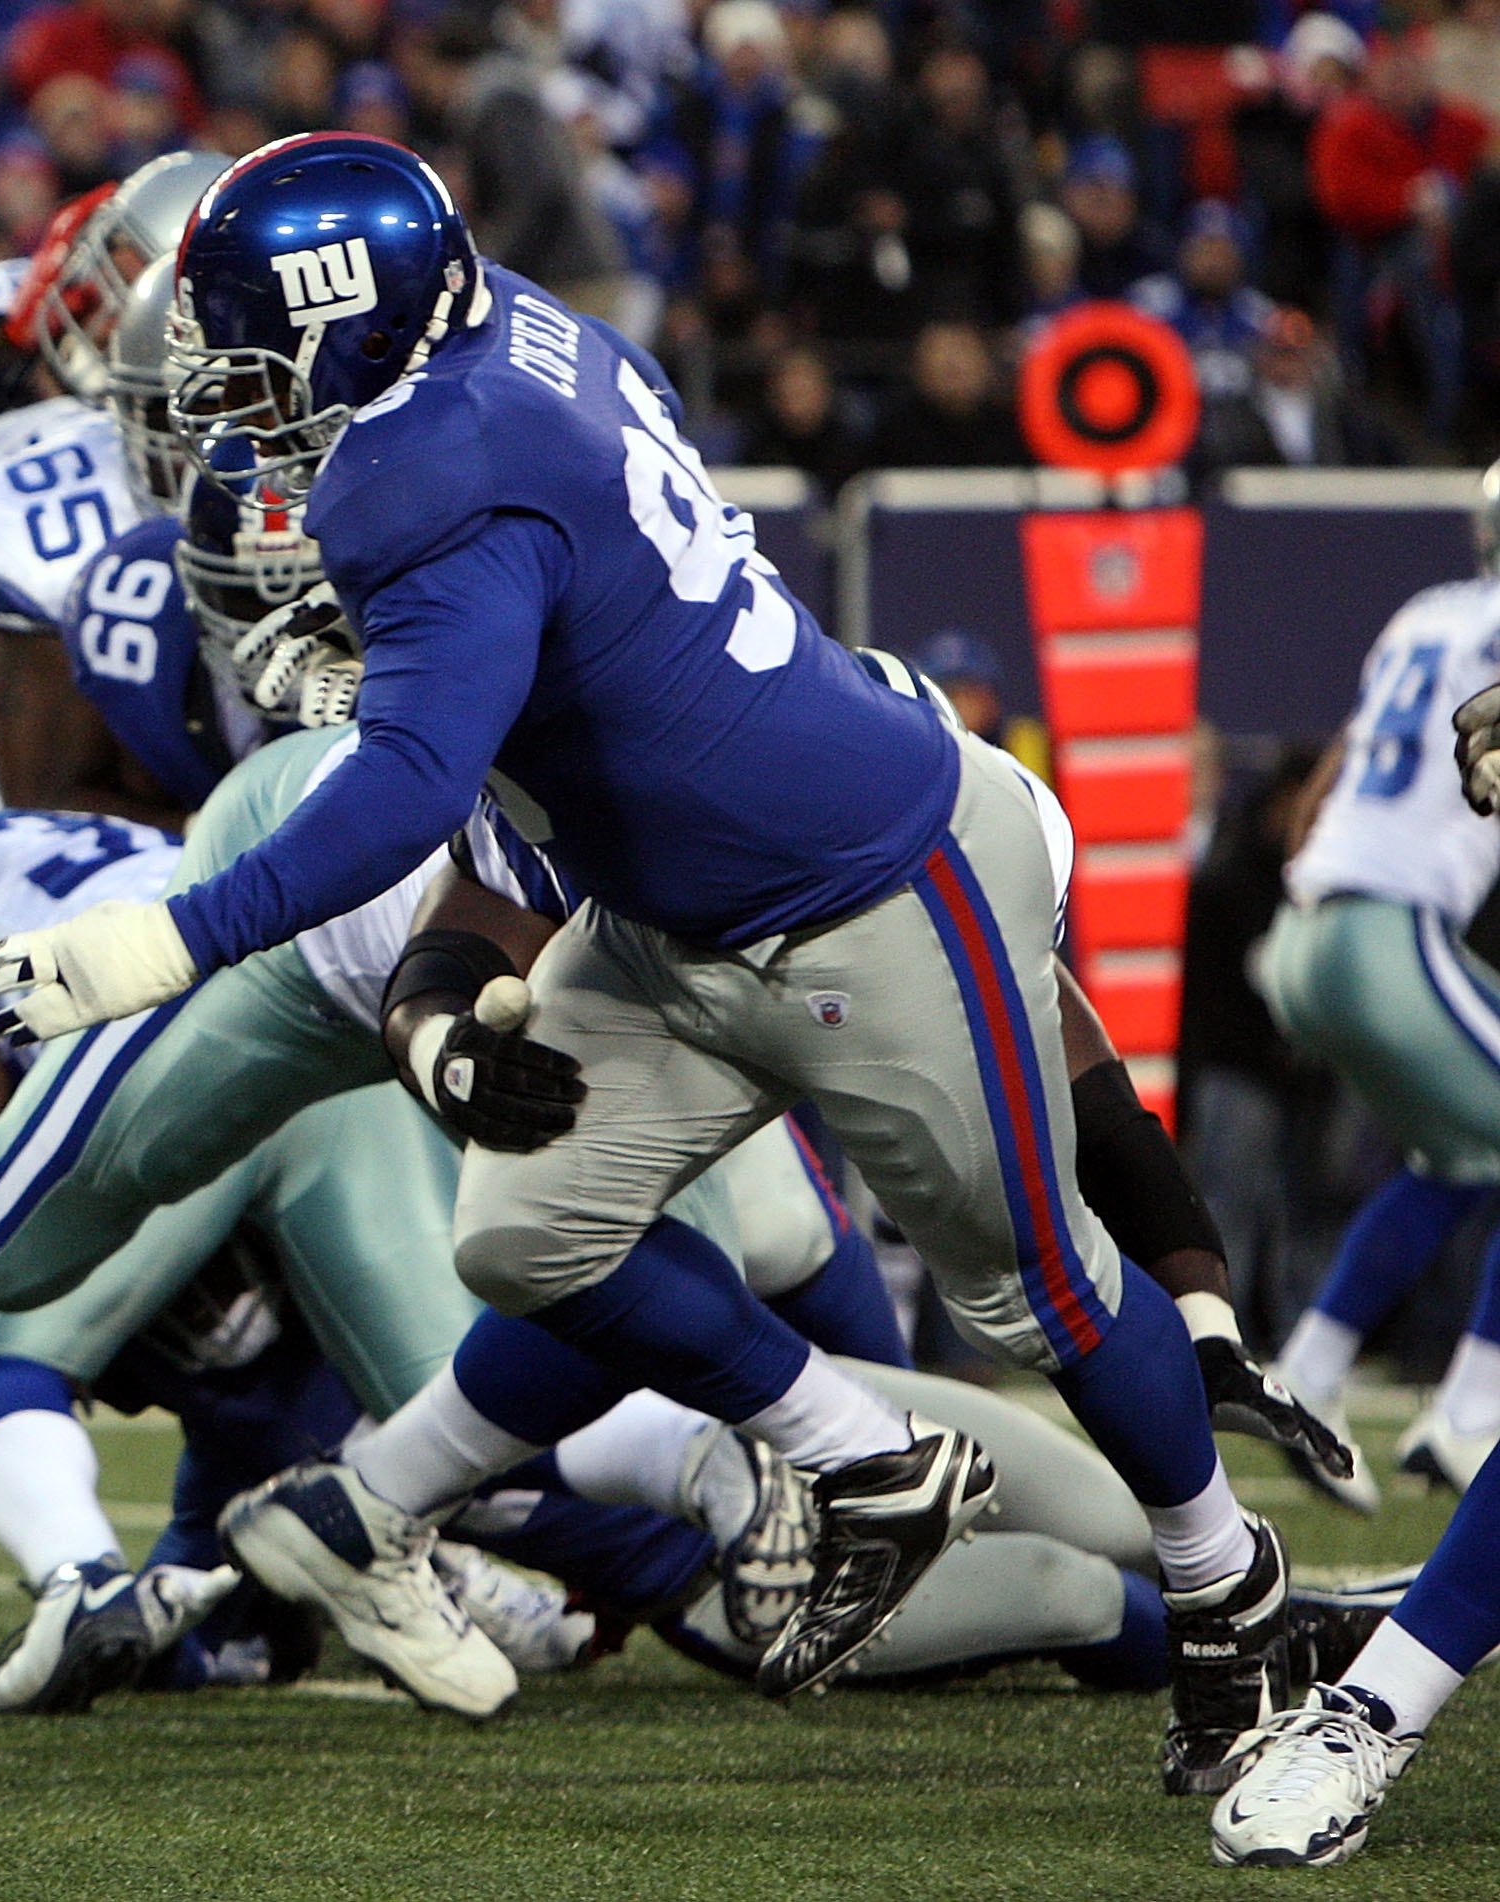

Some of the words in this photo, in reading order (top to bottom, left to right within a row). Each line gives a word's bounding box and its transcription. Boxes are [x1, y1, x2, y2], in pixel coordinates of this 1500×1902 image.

[509, 294, 581, 399] COFIELD
[6, 443, 114, 562] 65
[80, 554, 173, 685] 99
[1182, 1641, 1239, 1658] Reebok
